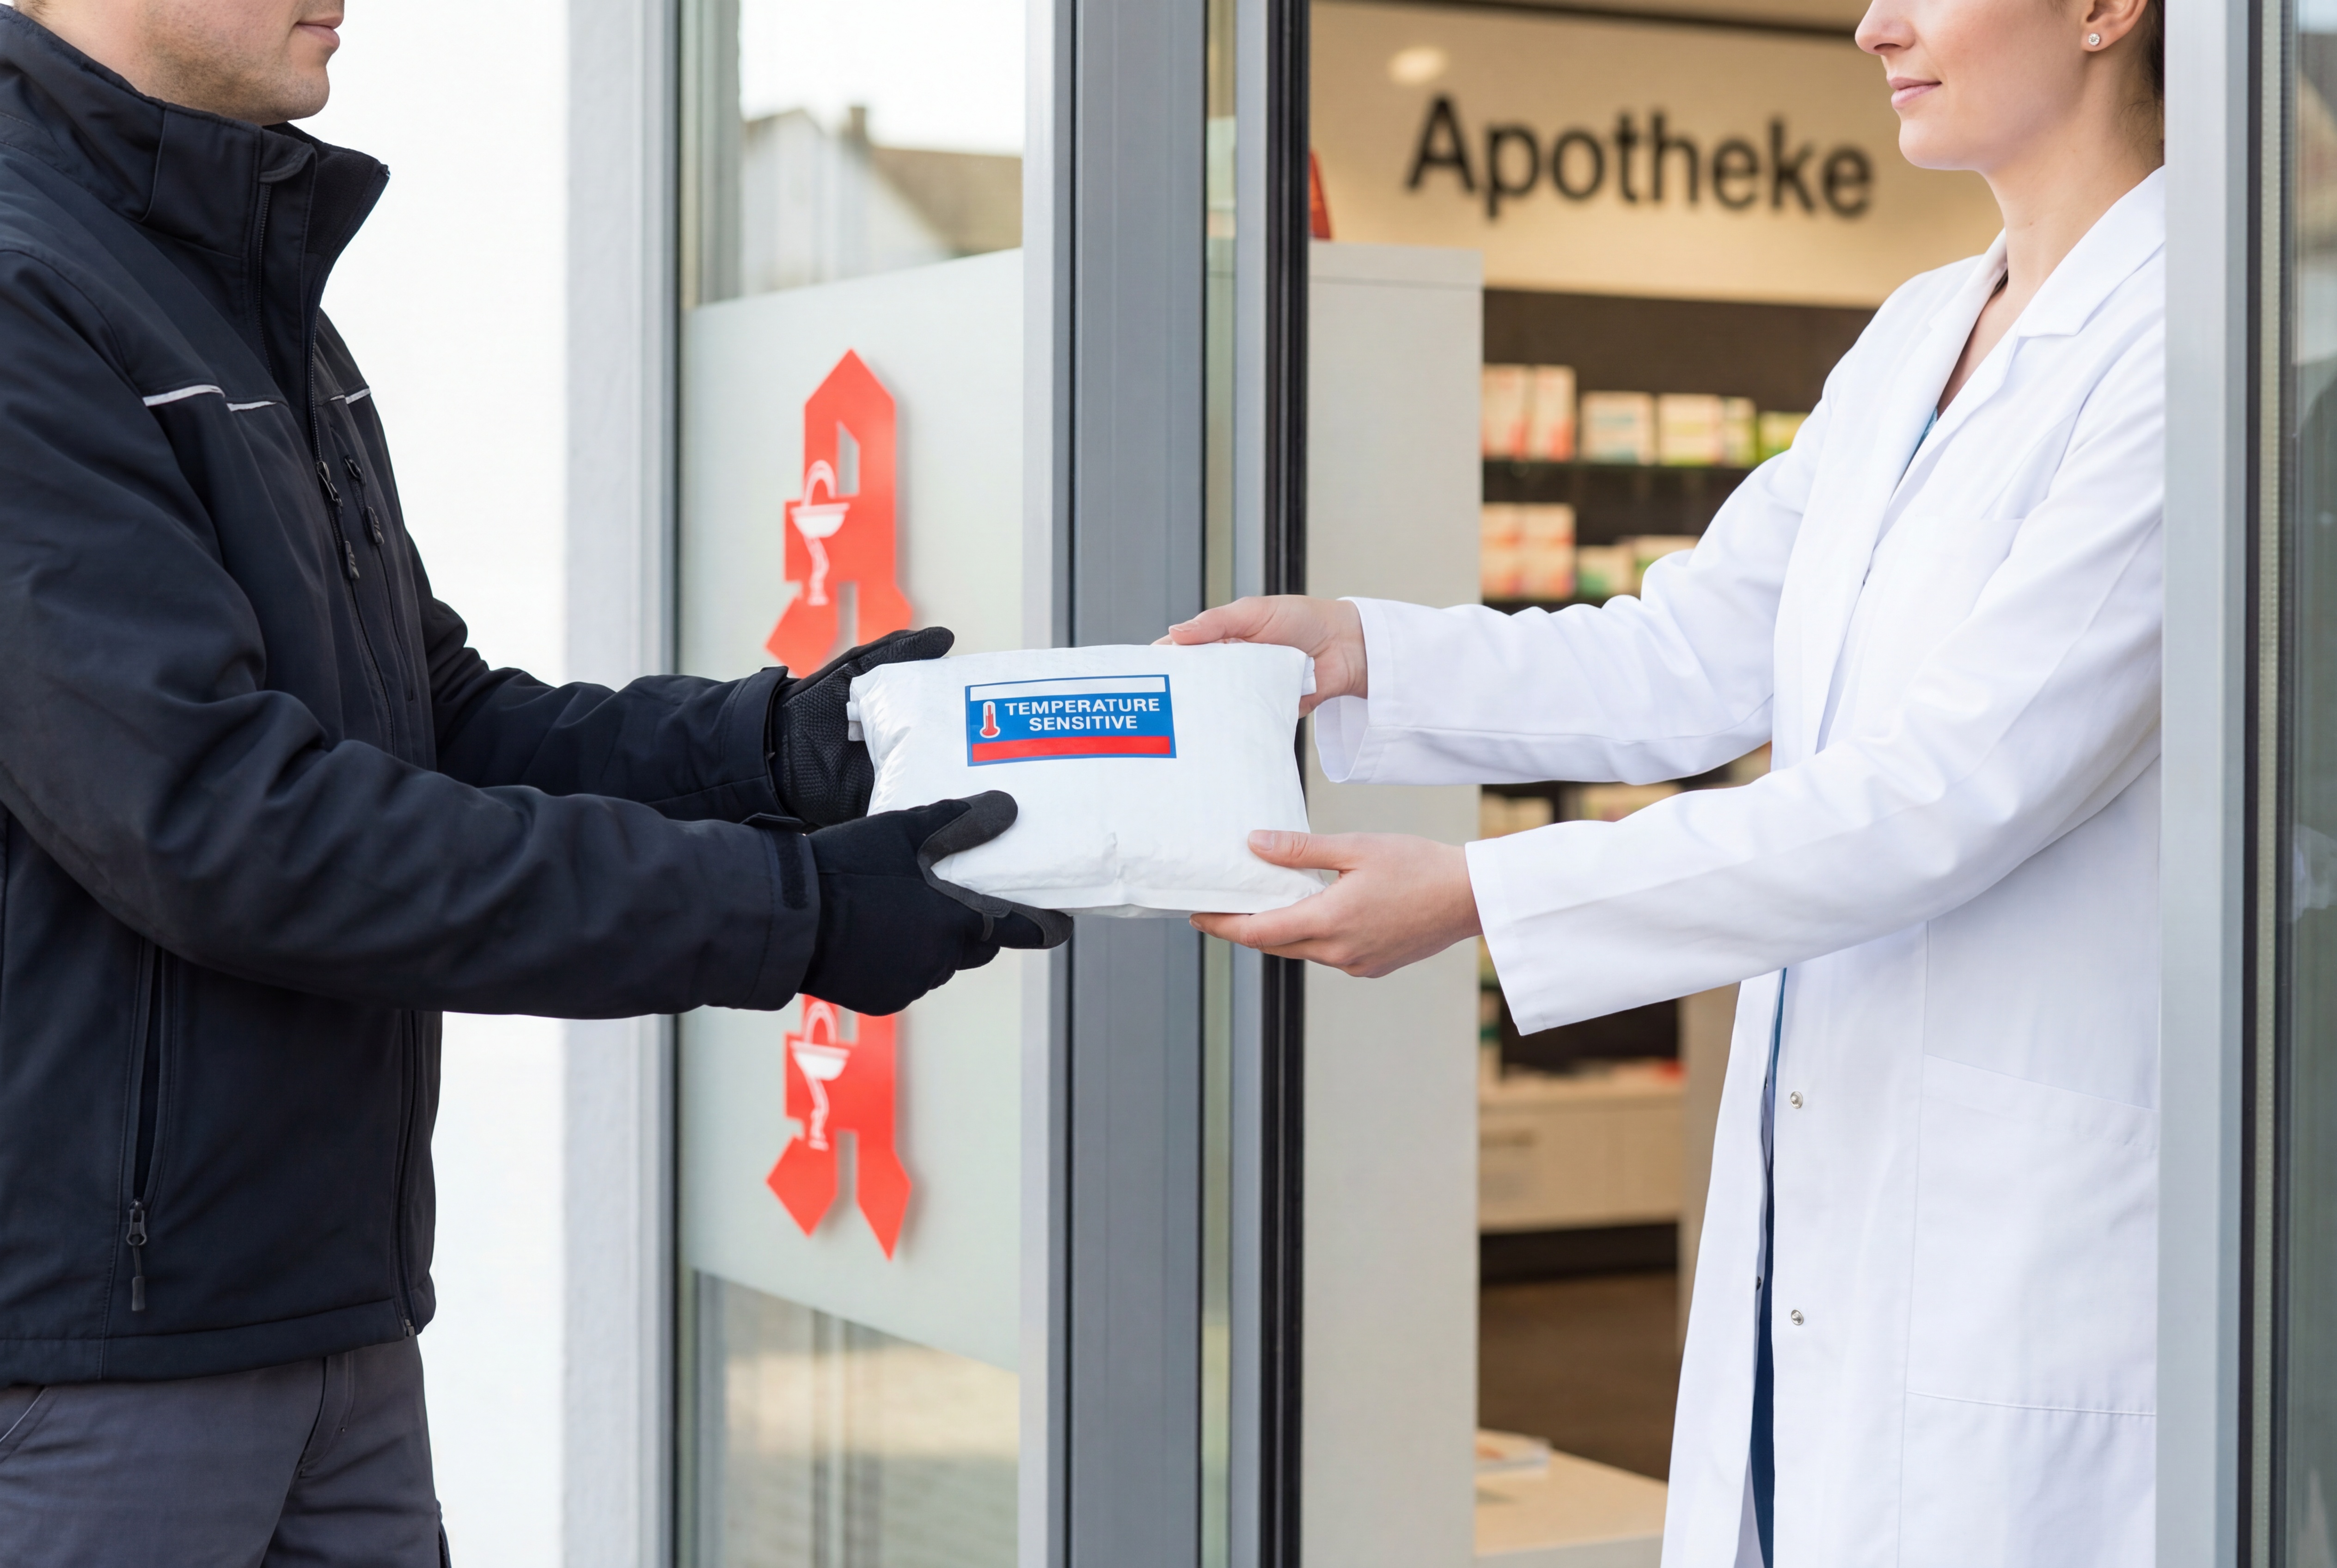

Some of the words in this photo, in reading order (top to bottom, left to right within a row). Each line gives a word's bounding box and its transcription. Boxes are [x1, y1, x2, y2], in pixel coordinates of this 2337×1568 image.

[1405, 94, 1874, 222] Apotheke
[1005, 698, 1160, 716] TEMPERATURE
[1029, 716, 1138, 731] SENSITIVE
